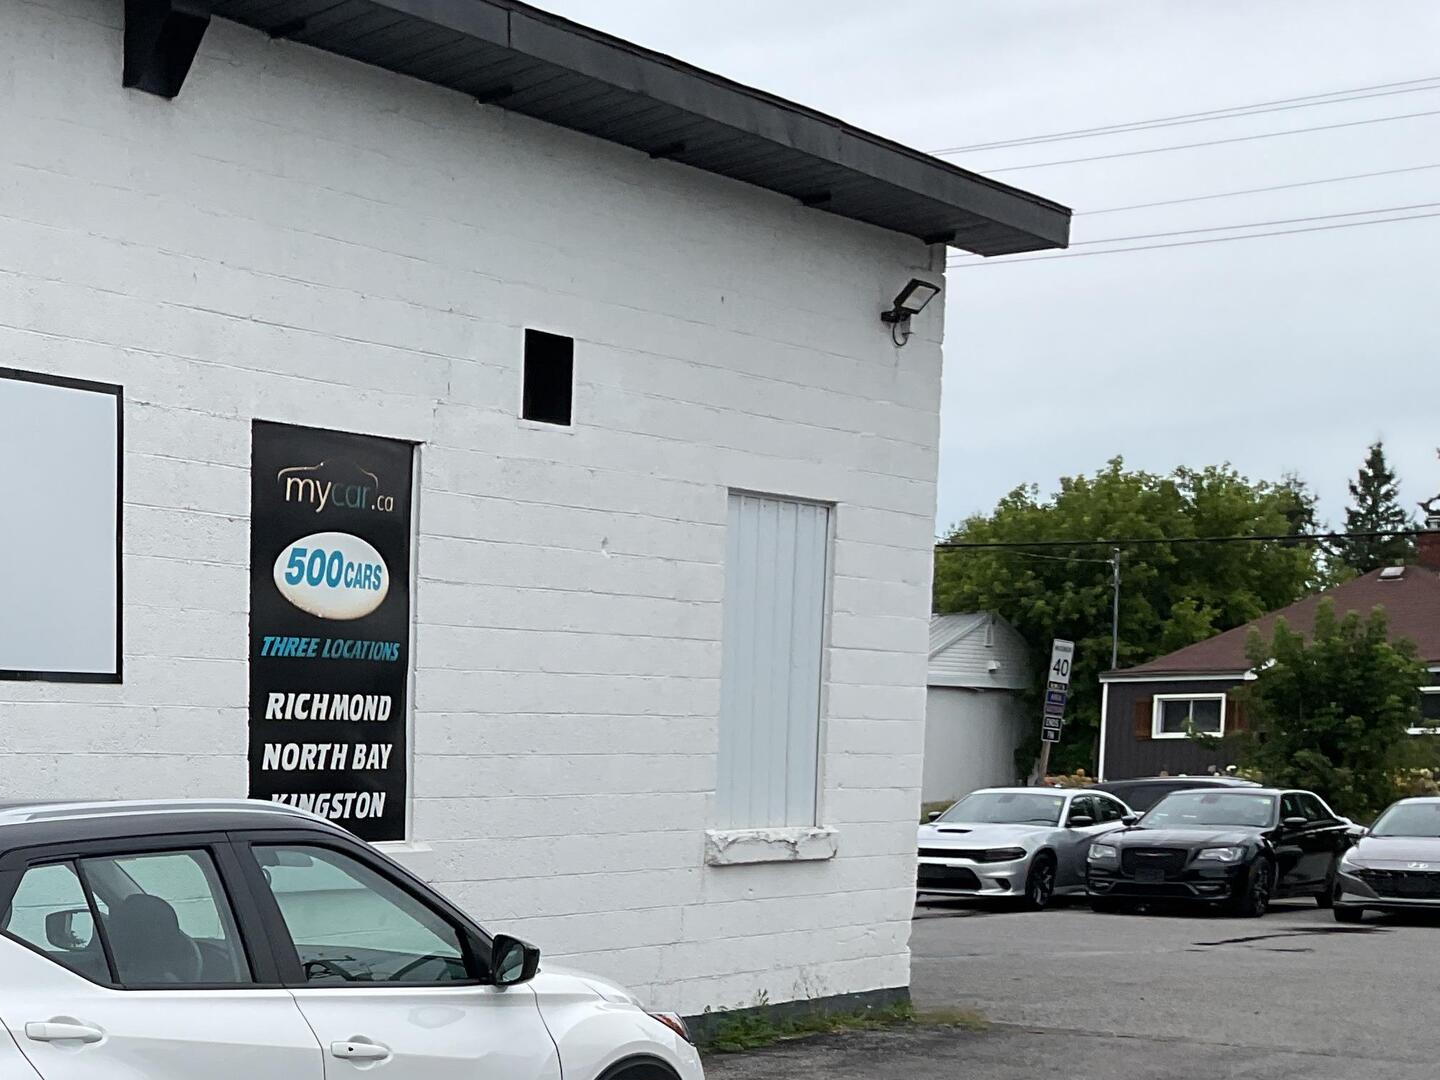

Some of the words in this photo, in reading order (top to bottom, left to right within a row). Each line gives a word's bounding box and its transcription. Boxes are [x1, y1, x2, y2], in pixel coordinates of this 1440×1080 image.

[261, 636, 320, 658] THREE
[321, 639, 400, 662] LOCATIONS
[1052, 658, 1069, 677] 40
[265, 692, 392, 722] RICHMOND
[262, 743, 349, 771] NORTH
[352, 743, 392, 771] BAY
